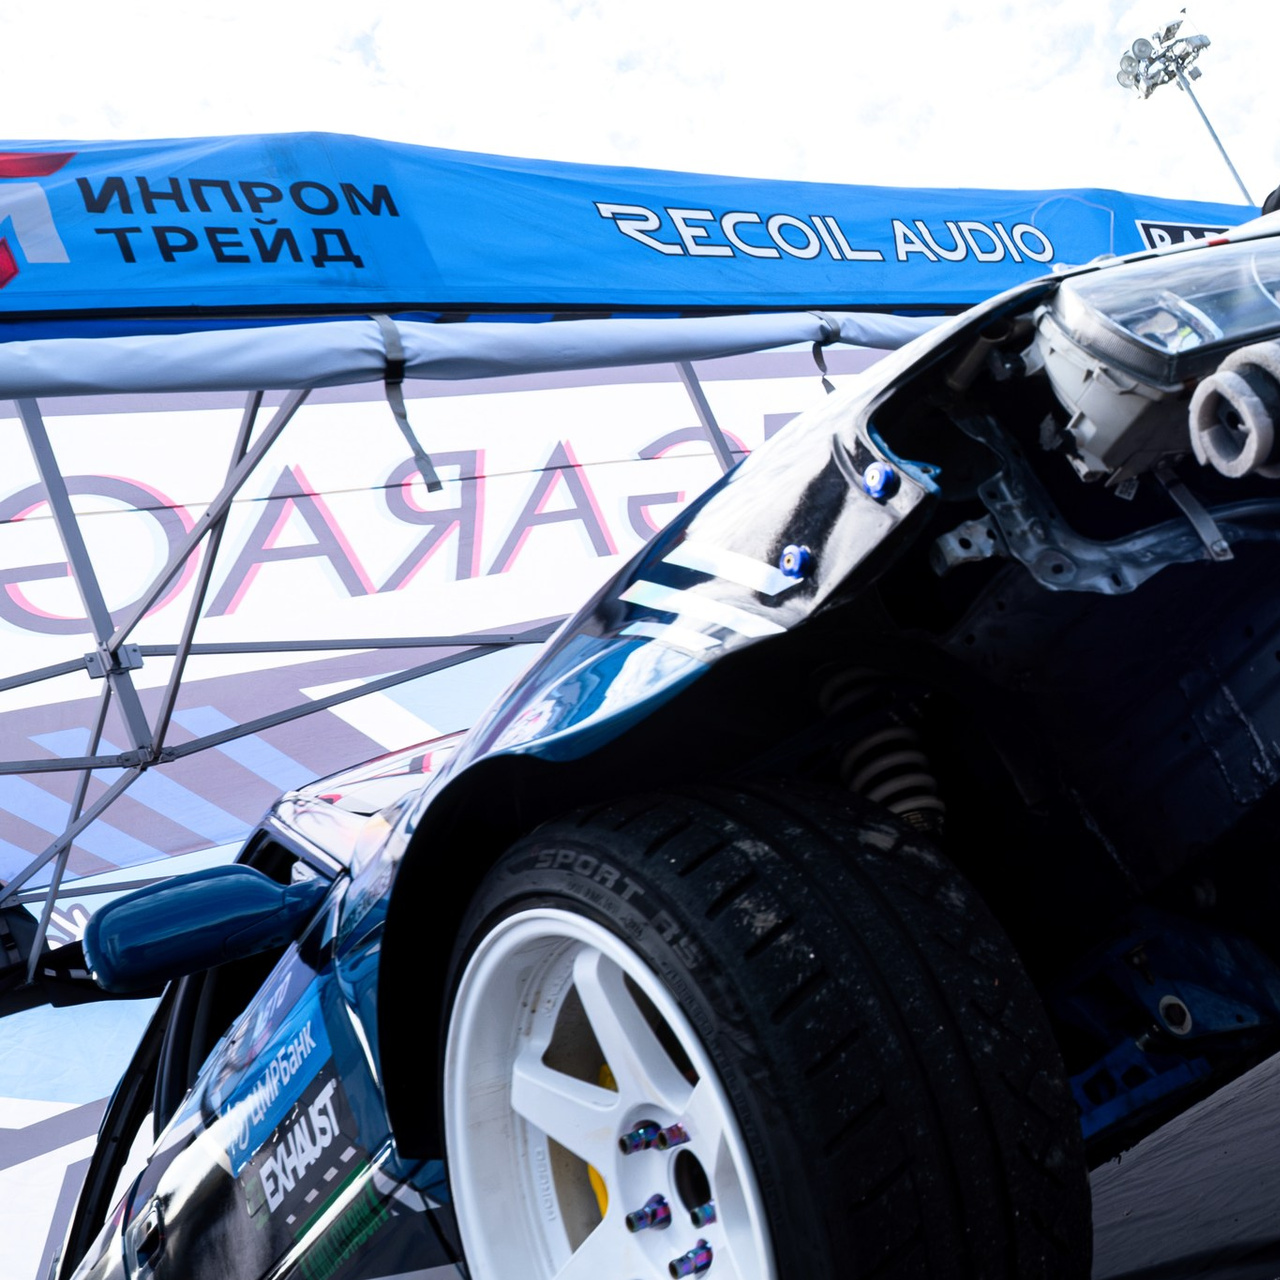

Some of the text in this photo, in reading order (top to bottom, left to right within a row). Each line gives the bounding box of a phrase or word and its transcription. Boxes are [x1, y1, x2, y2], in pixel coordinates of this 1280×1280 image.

[74, 176, 400, 217] ИНПРОМ
[96, 217, 365, 269] ТРЕЙД
[593, 201, 1055, 264] RECOIL AUDIO
[534, 848, 646, 901] SPORT
[259, 1081, 341, 1213] EXHAUST
